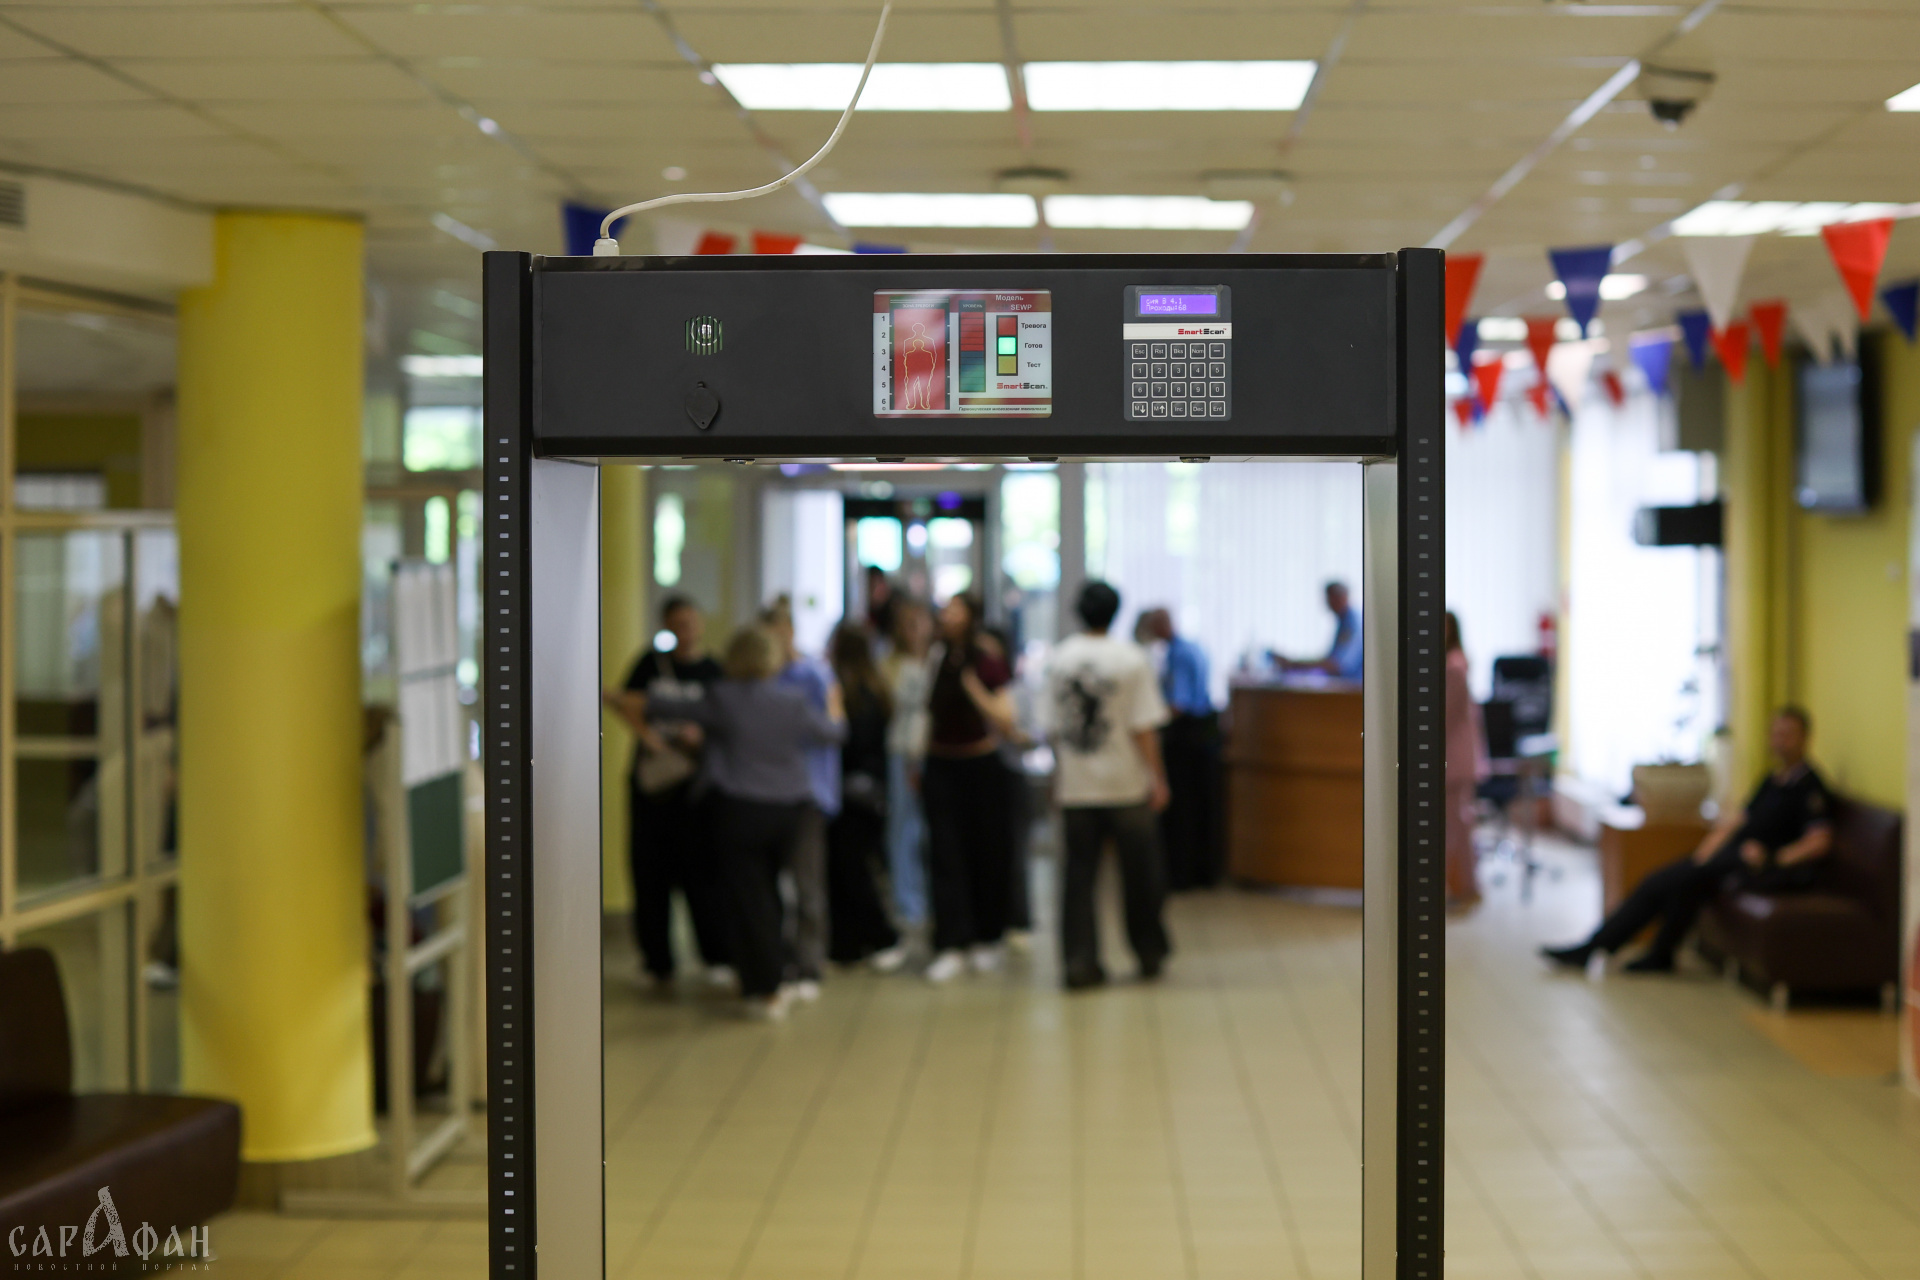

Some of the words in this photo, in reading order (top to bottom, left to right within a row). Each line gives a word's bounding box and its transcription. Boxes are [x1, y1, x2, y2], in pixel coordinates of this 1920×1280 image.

[995, 294, 1024, 302] Модель
[1170, 297, 1182, 305] 4.1
[1021, 322, 1047, 330] Тревога
